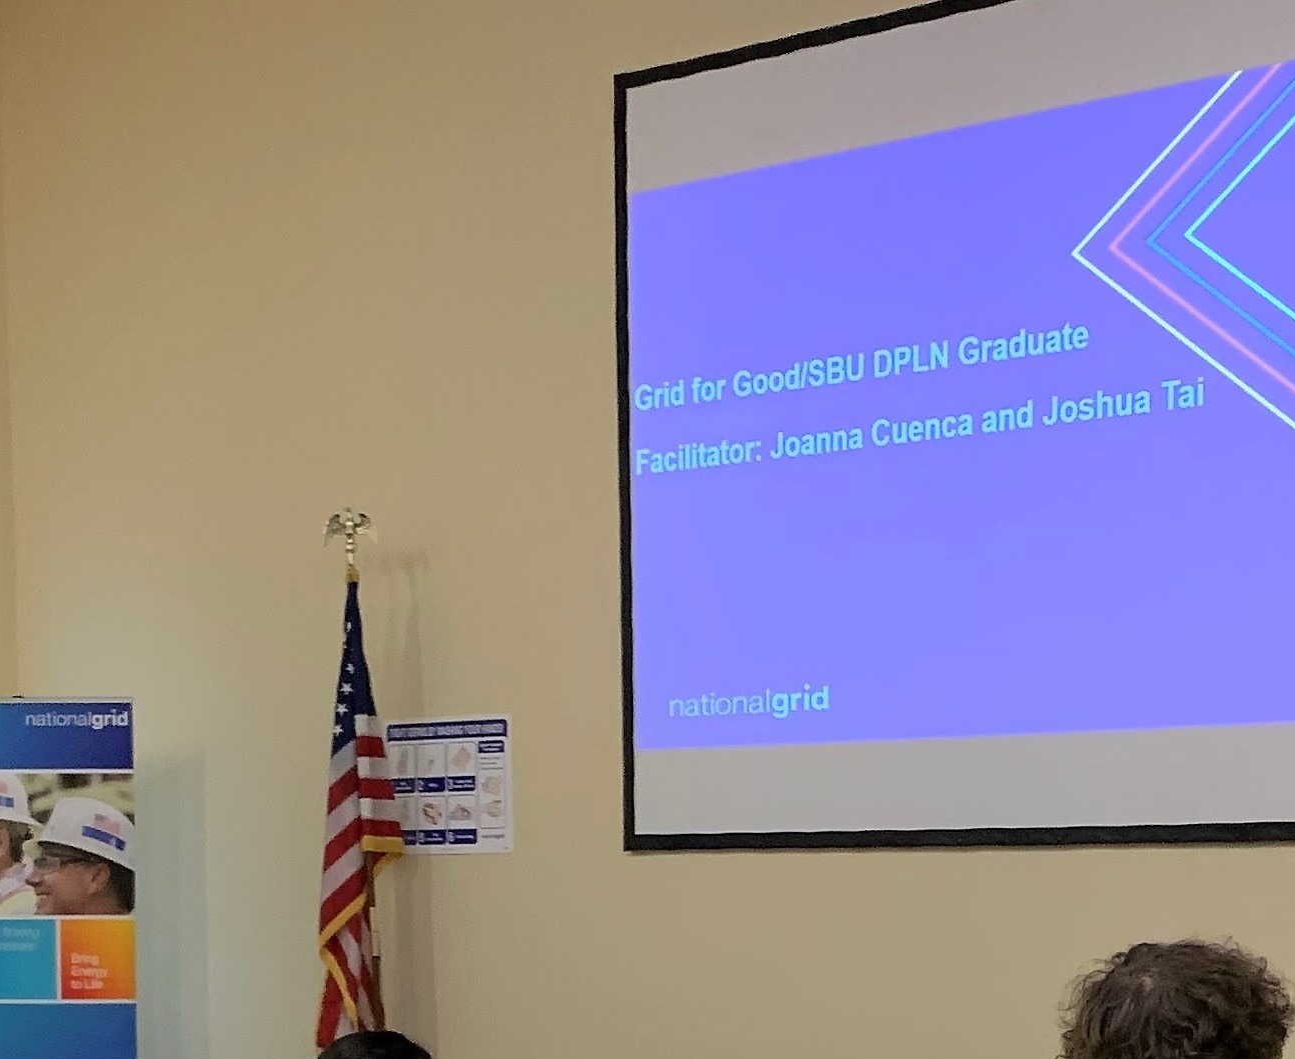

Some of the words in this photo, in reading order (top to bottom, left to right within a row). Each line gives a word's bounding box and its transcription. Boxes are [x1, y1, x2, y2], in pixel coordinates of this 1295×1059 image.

[634, 381, 685, 411] Grid
[691, 376, 726, 404] for
[732, 352, 865, 398] Good/SBU
[873, 341, 949, 378] DPLN
[957, 322, 1091, 366] Graduate
[635, 437, 762, 476] Facilitator:
[769, 426, 864, 460] Joanna
[871, 413, 974, 447] Cuenca
[981, 399, 1034, 433] and
[1042, 387, 1152, 426] Joshua
[1161, 376, 1206, 411] Tai
[24, 708, 129, 731] nationalgrid
[668, 684, 831, 719] nationalgrid
